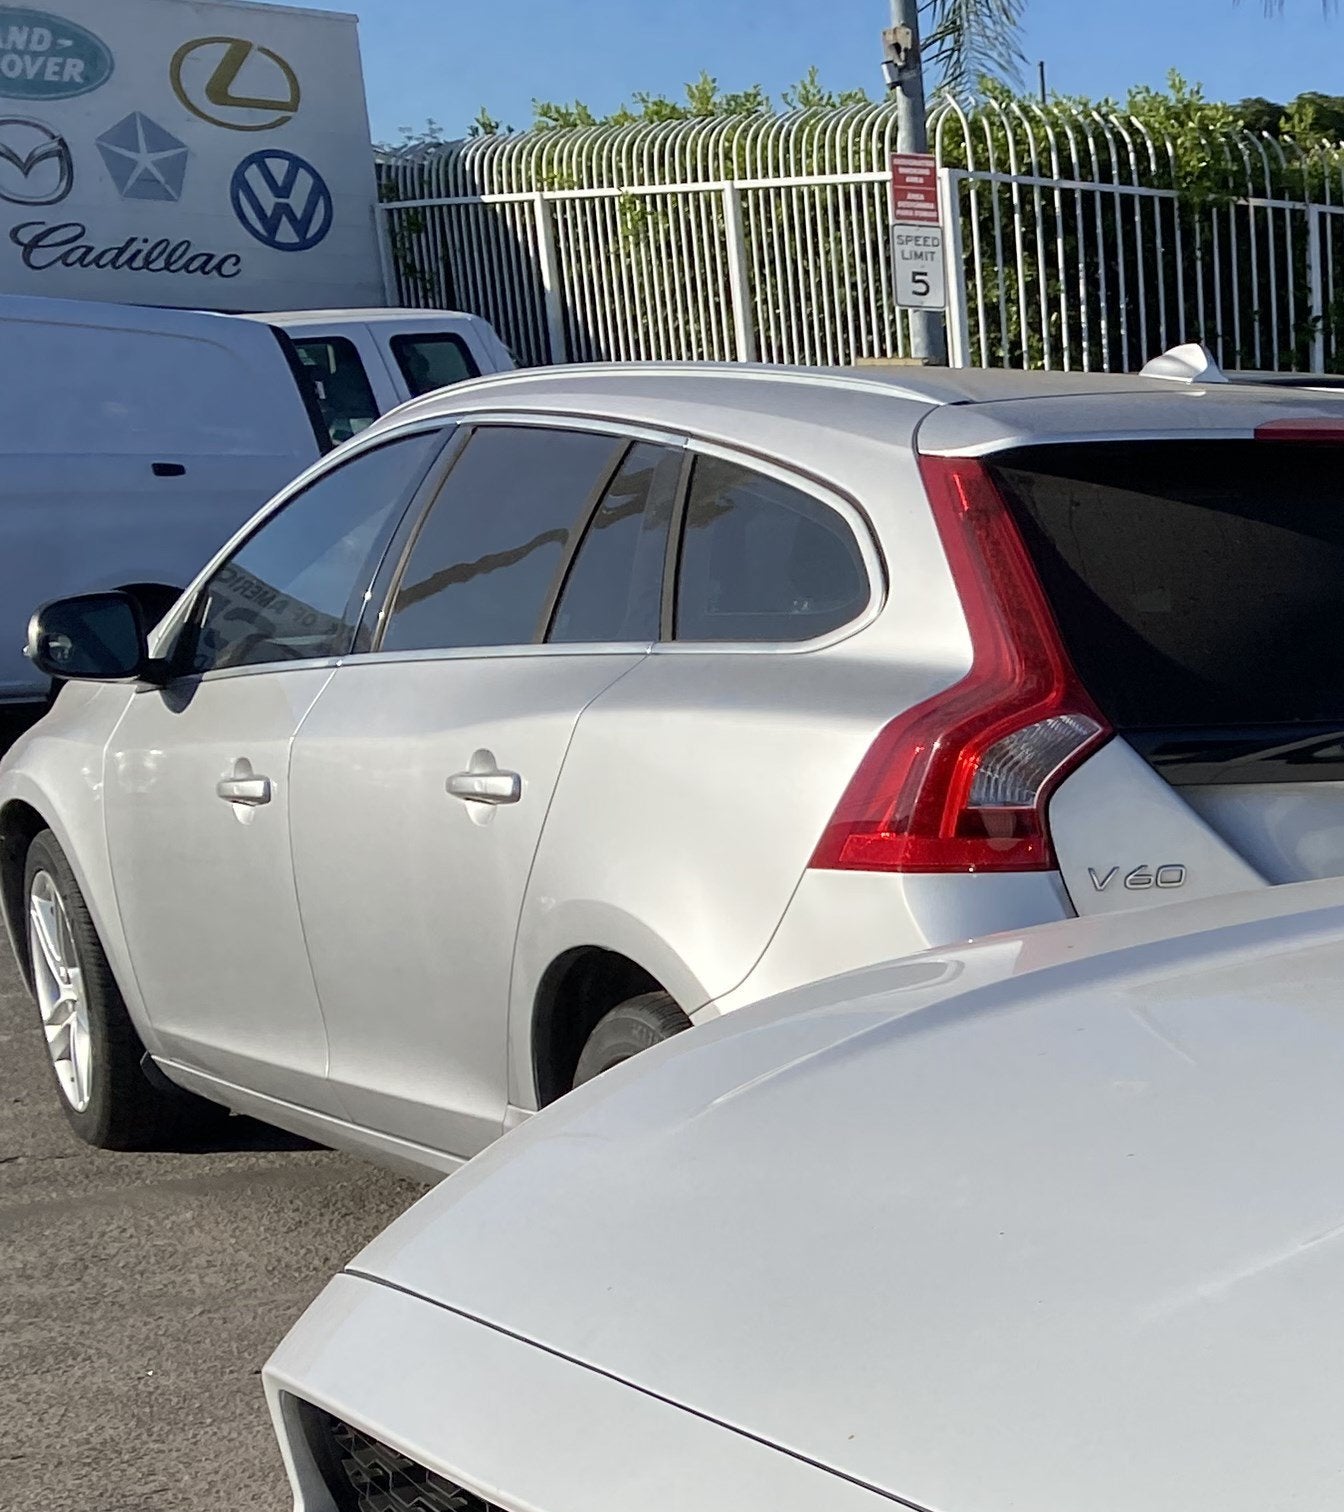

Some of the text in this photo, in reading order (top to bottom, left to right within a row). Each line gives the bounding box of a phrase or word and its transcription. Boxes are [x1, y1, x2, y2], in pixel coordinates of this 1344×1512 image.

[0, 53, 85, 84] OVER
[9, 221, 242, 279] Cadillac
[896, 234, 940, 248] SPEED
[901, 251, 937, 262] LIMIT
[911, 271, 930, 296] 5
[1087, 865, 1188, 892] V60
